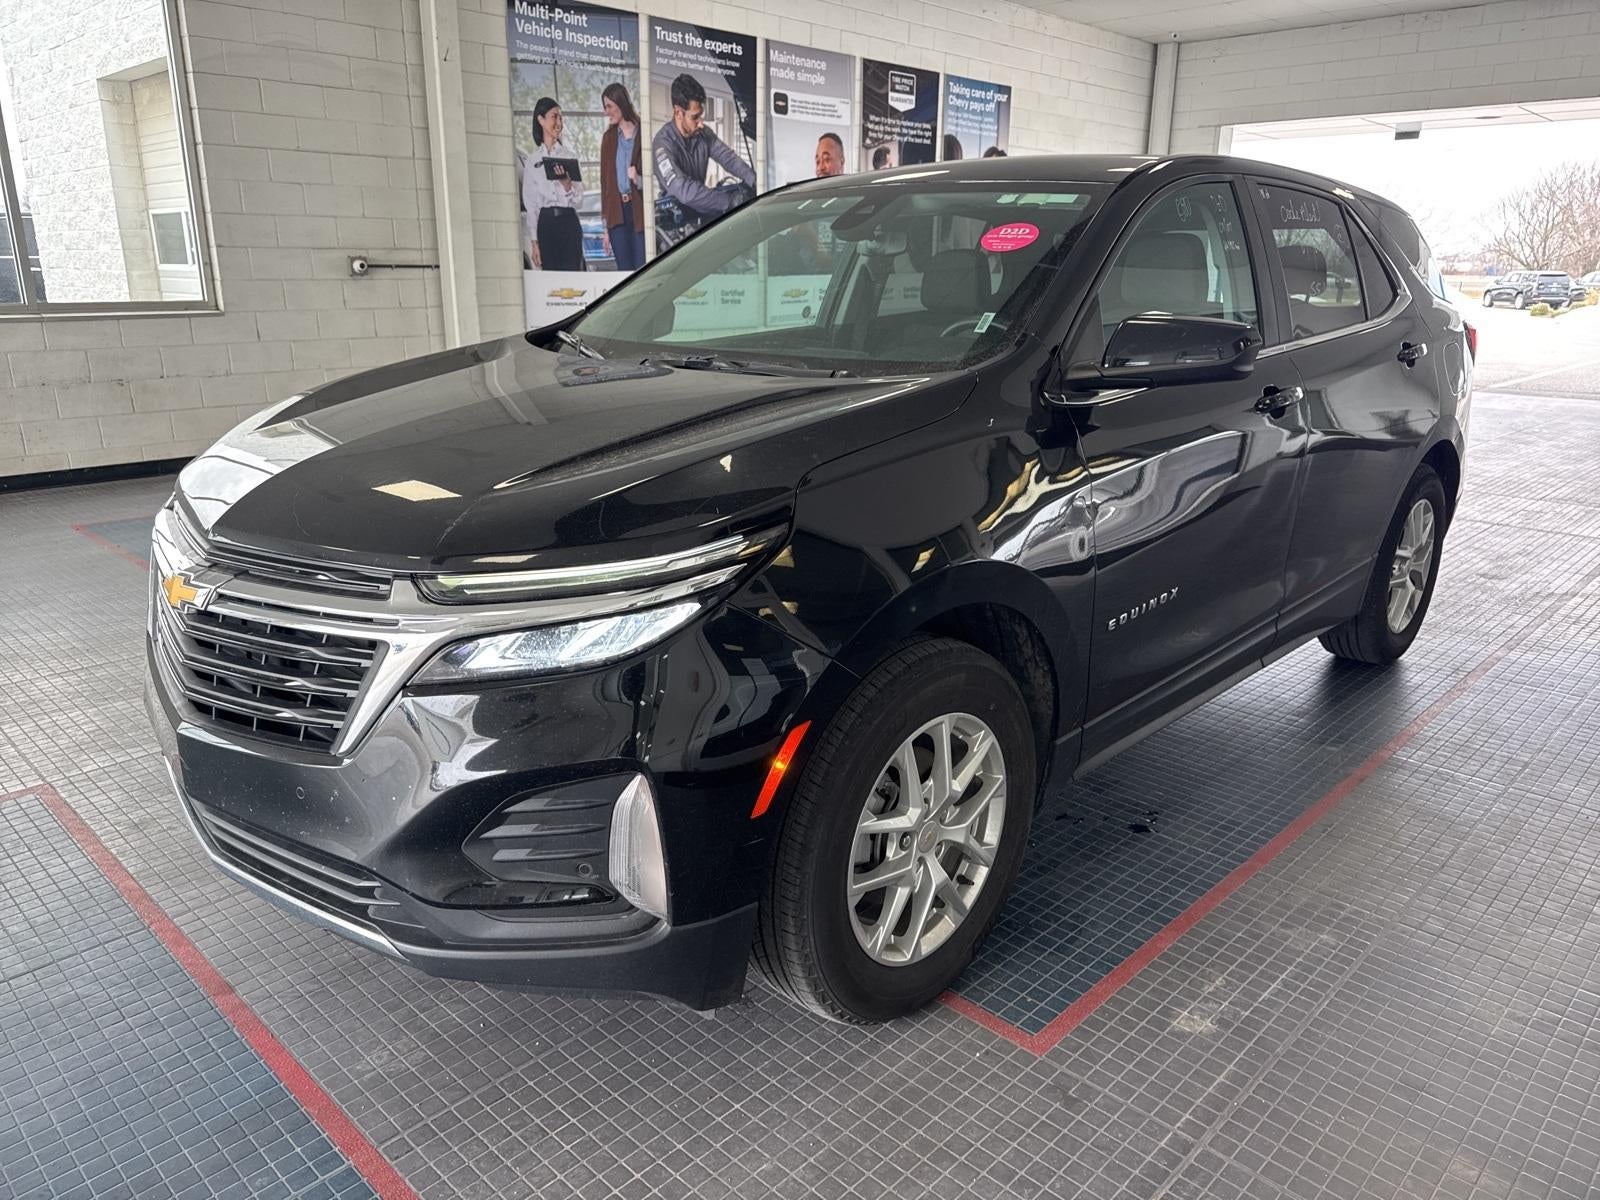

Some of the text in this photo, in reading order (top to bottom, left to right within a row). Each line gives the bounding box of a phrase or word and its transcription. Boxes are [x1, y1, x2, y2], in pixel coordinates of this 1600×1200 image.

[514, 0, 588, 27] Multi-Point
[515, 18, 628, 52] Vehicle Inspection
[654, 26, 743, 56] Trust the experts
[656, 45, 741, 68] Factory-trained technicians know
[669, 59, 687, 68] vehicle
[688, 61, 704, 71] better
[769, 48, 827, 71] Maintenance
[769, 66, 826, 86] made simple
[902, 77, 914, 86] PRICE
[949, 82, 1008, 102] Taking care of your
[949, 95, 996, 112] Chevy pays off
[720, 288, 745, 297] Certified
[720, 297, 741, 305] Service
[1107, 586, 1179, 631] EQUINOX
